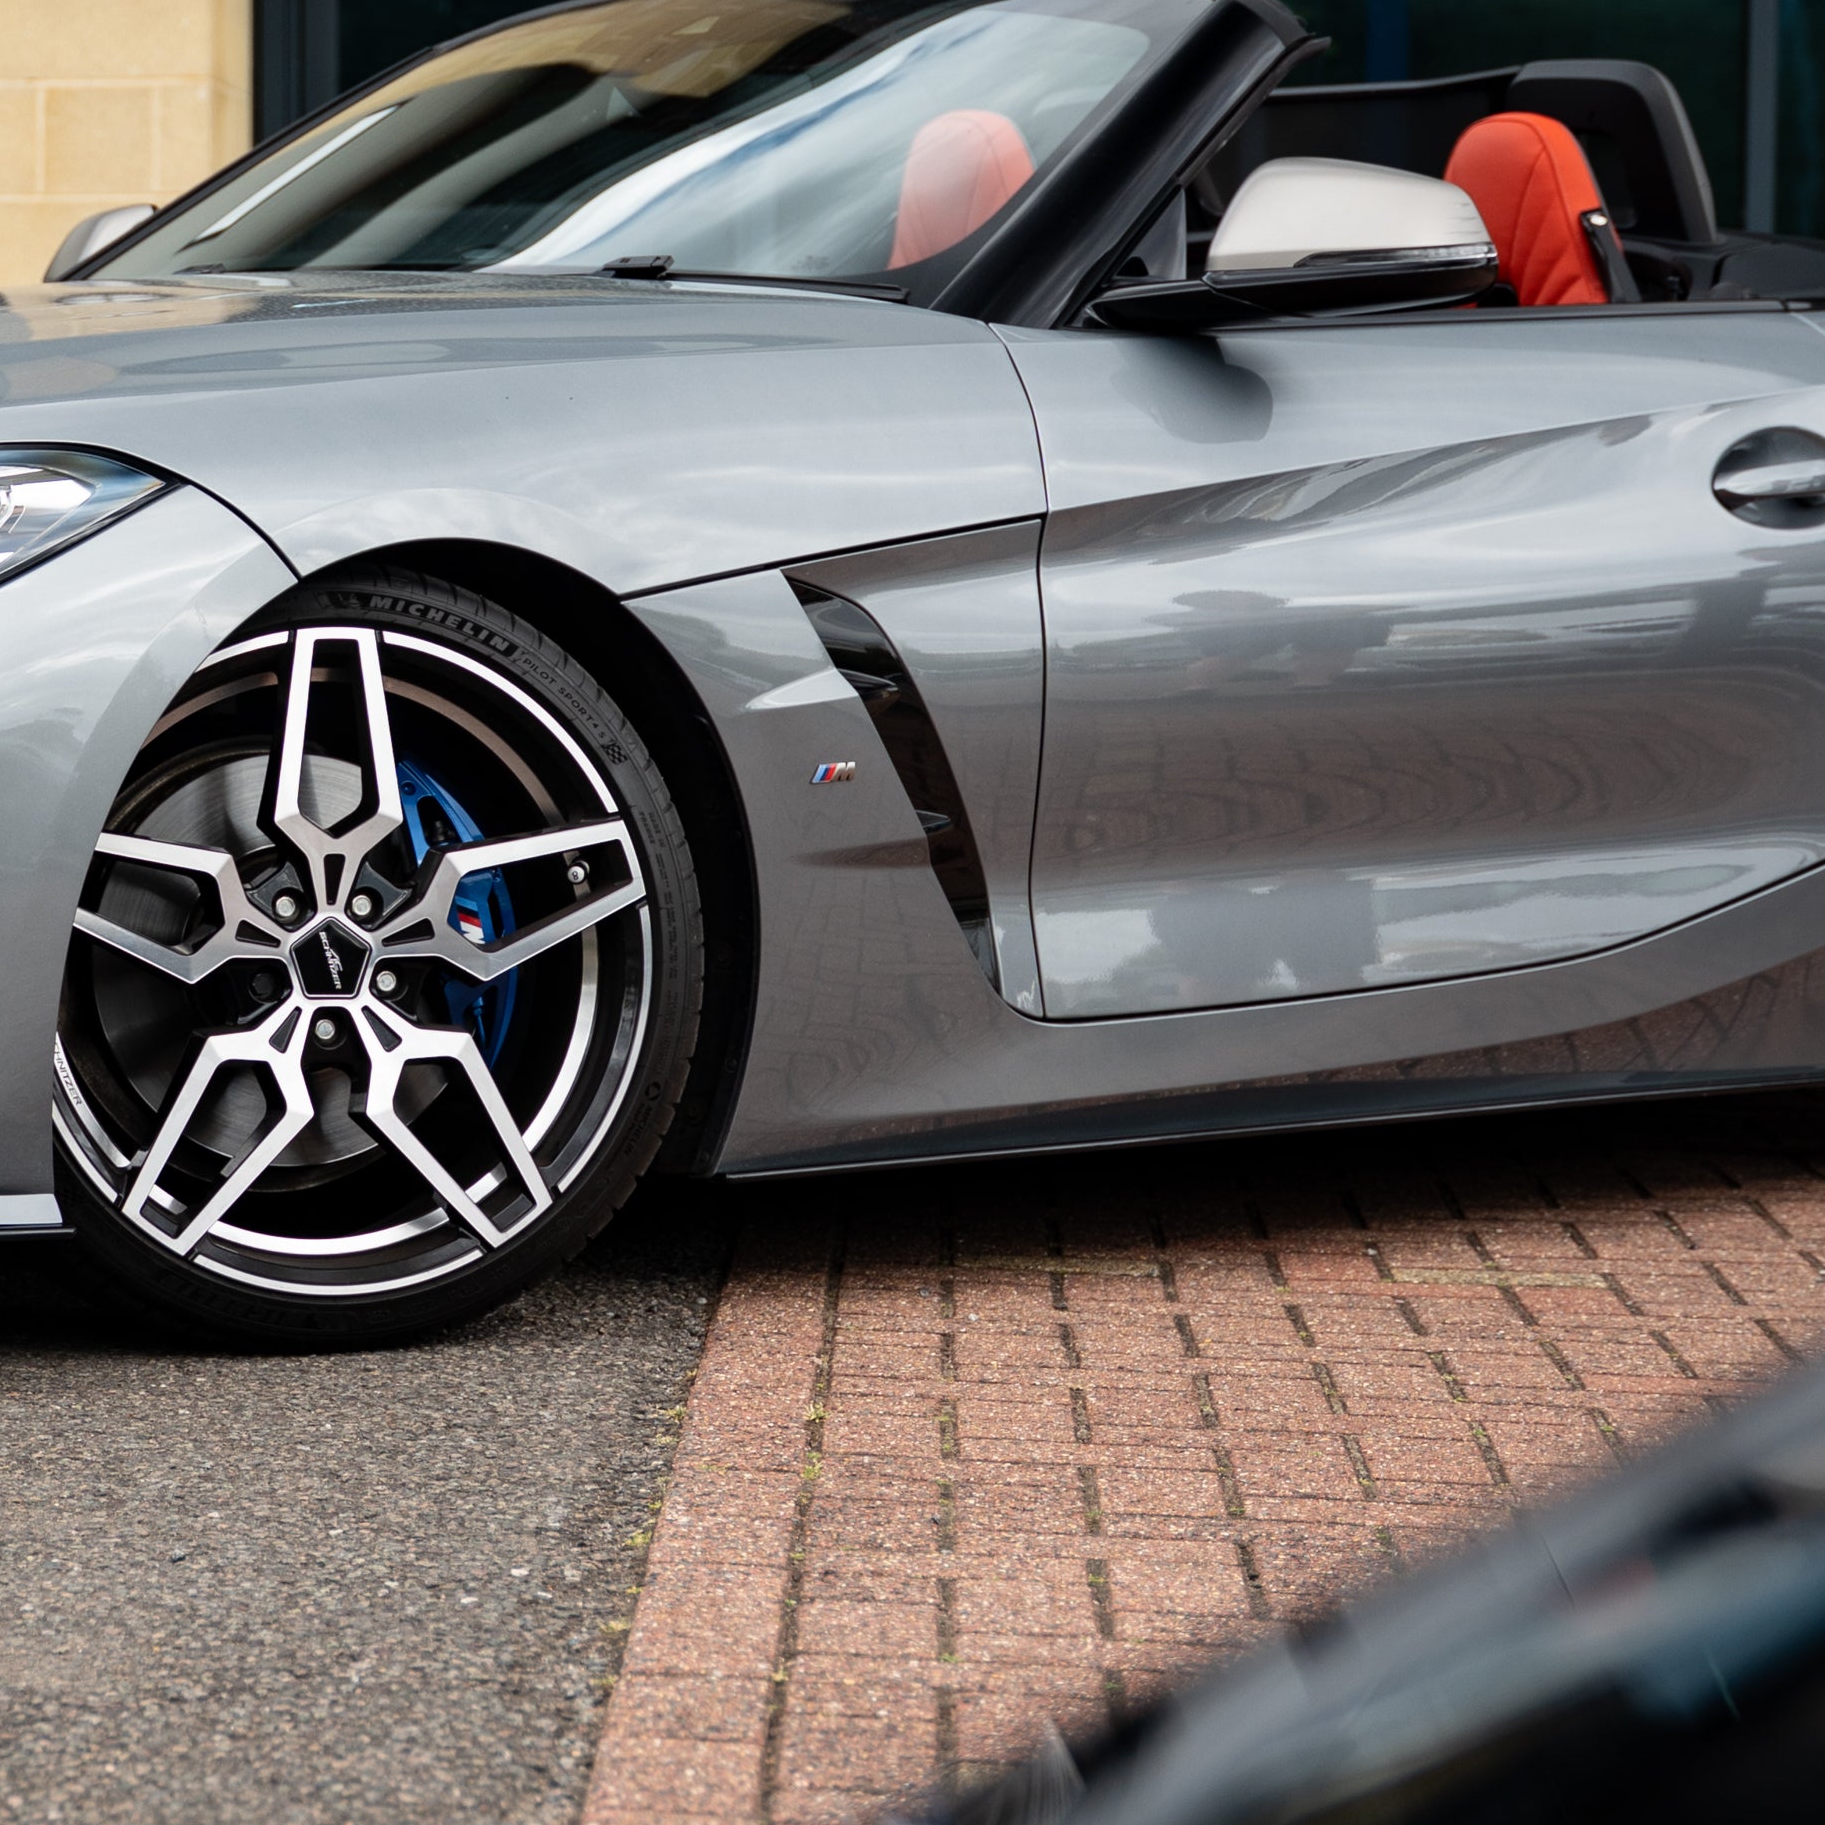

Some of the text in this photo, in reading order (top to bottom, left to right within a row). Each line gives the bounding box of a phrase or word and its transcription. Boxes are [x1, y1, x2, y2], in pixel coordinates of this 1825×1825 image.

[369, 595, 510, 651] MICHELIN
[523, 658, 557, 684] PILOT
[558, 687, 592, 722] SPORT
